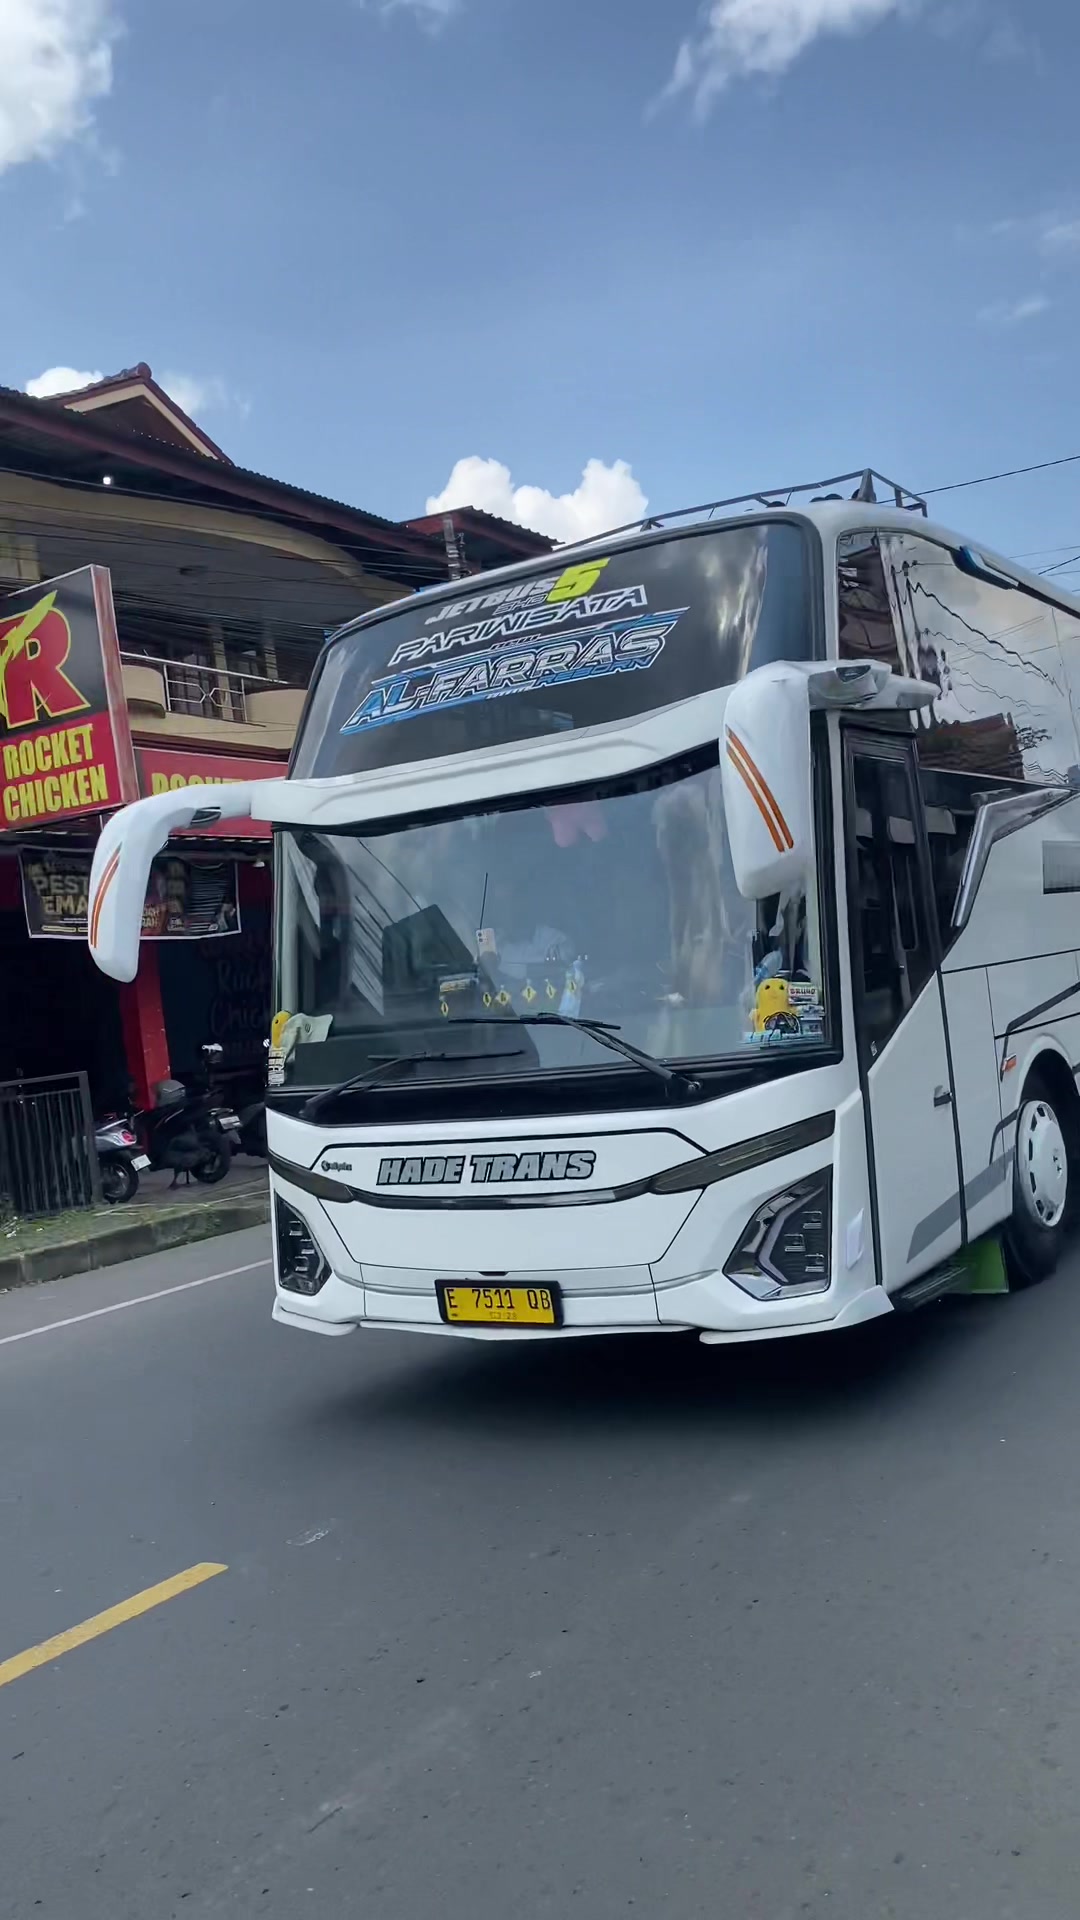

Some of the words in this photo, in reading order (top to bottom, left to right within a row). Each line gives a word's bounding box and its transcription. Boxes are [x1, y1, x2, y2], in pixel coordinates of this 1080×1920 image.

[387, 584, 648, 667] PARIWISATA
[3, 722, 94, 780] ROCKET
[3, 763, 109, 822] CHICKEN
[32, 874, 89, 896] PEST
[42, 894, 89, 915] EMA
[376, 1155, 466, 1185] HADE
[470, 1150, 597, 1183] TRANS
[446, 1288, 458, 1308] E
[472, 1289, 515, 1309] 7511
[527, 1289, 551, 1310] QB
